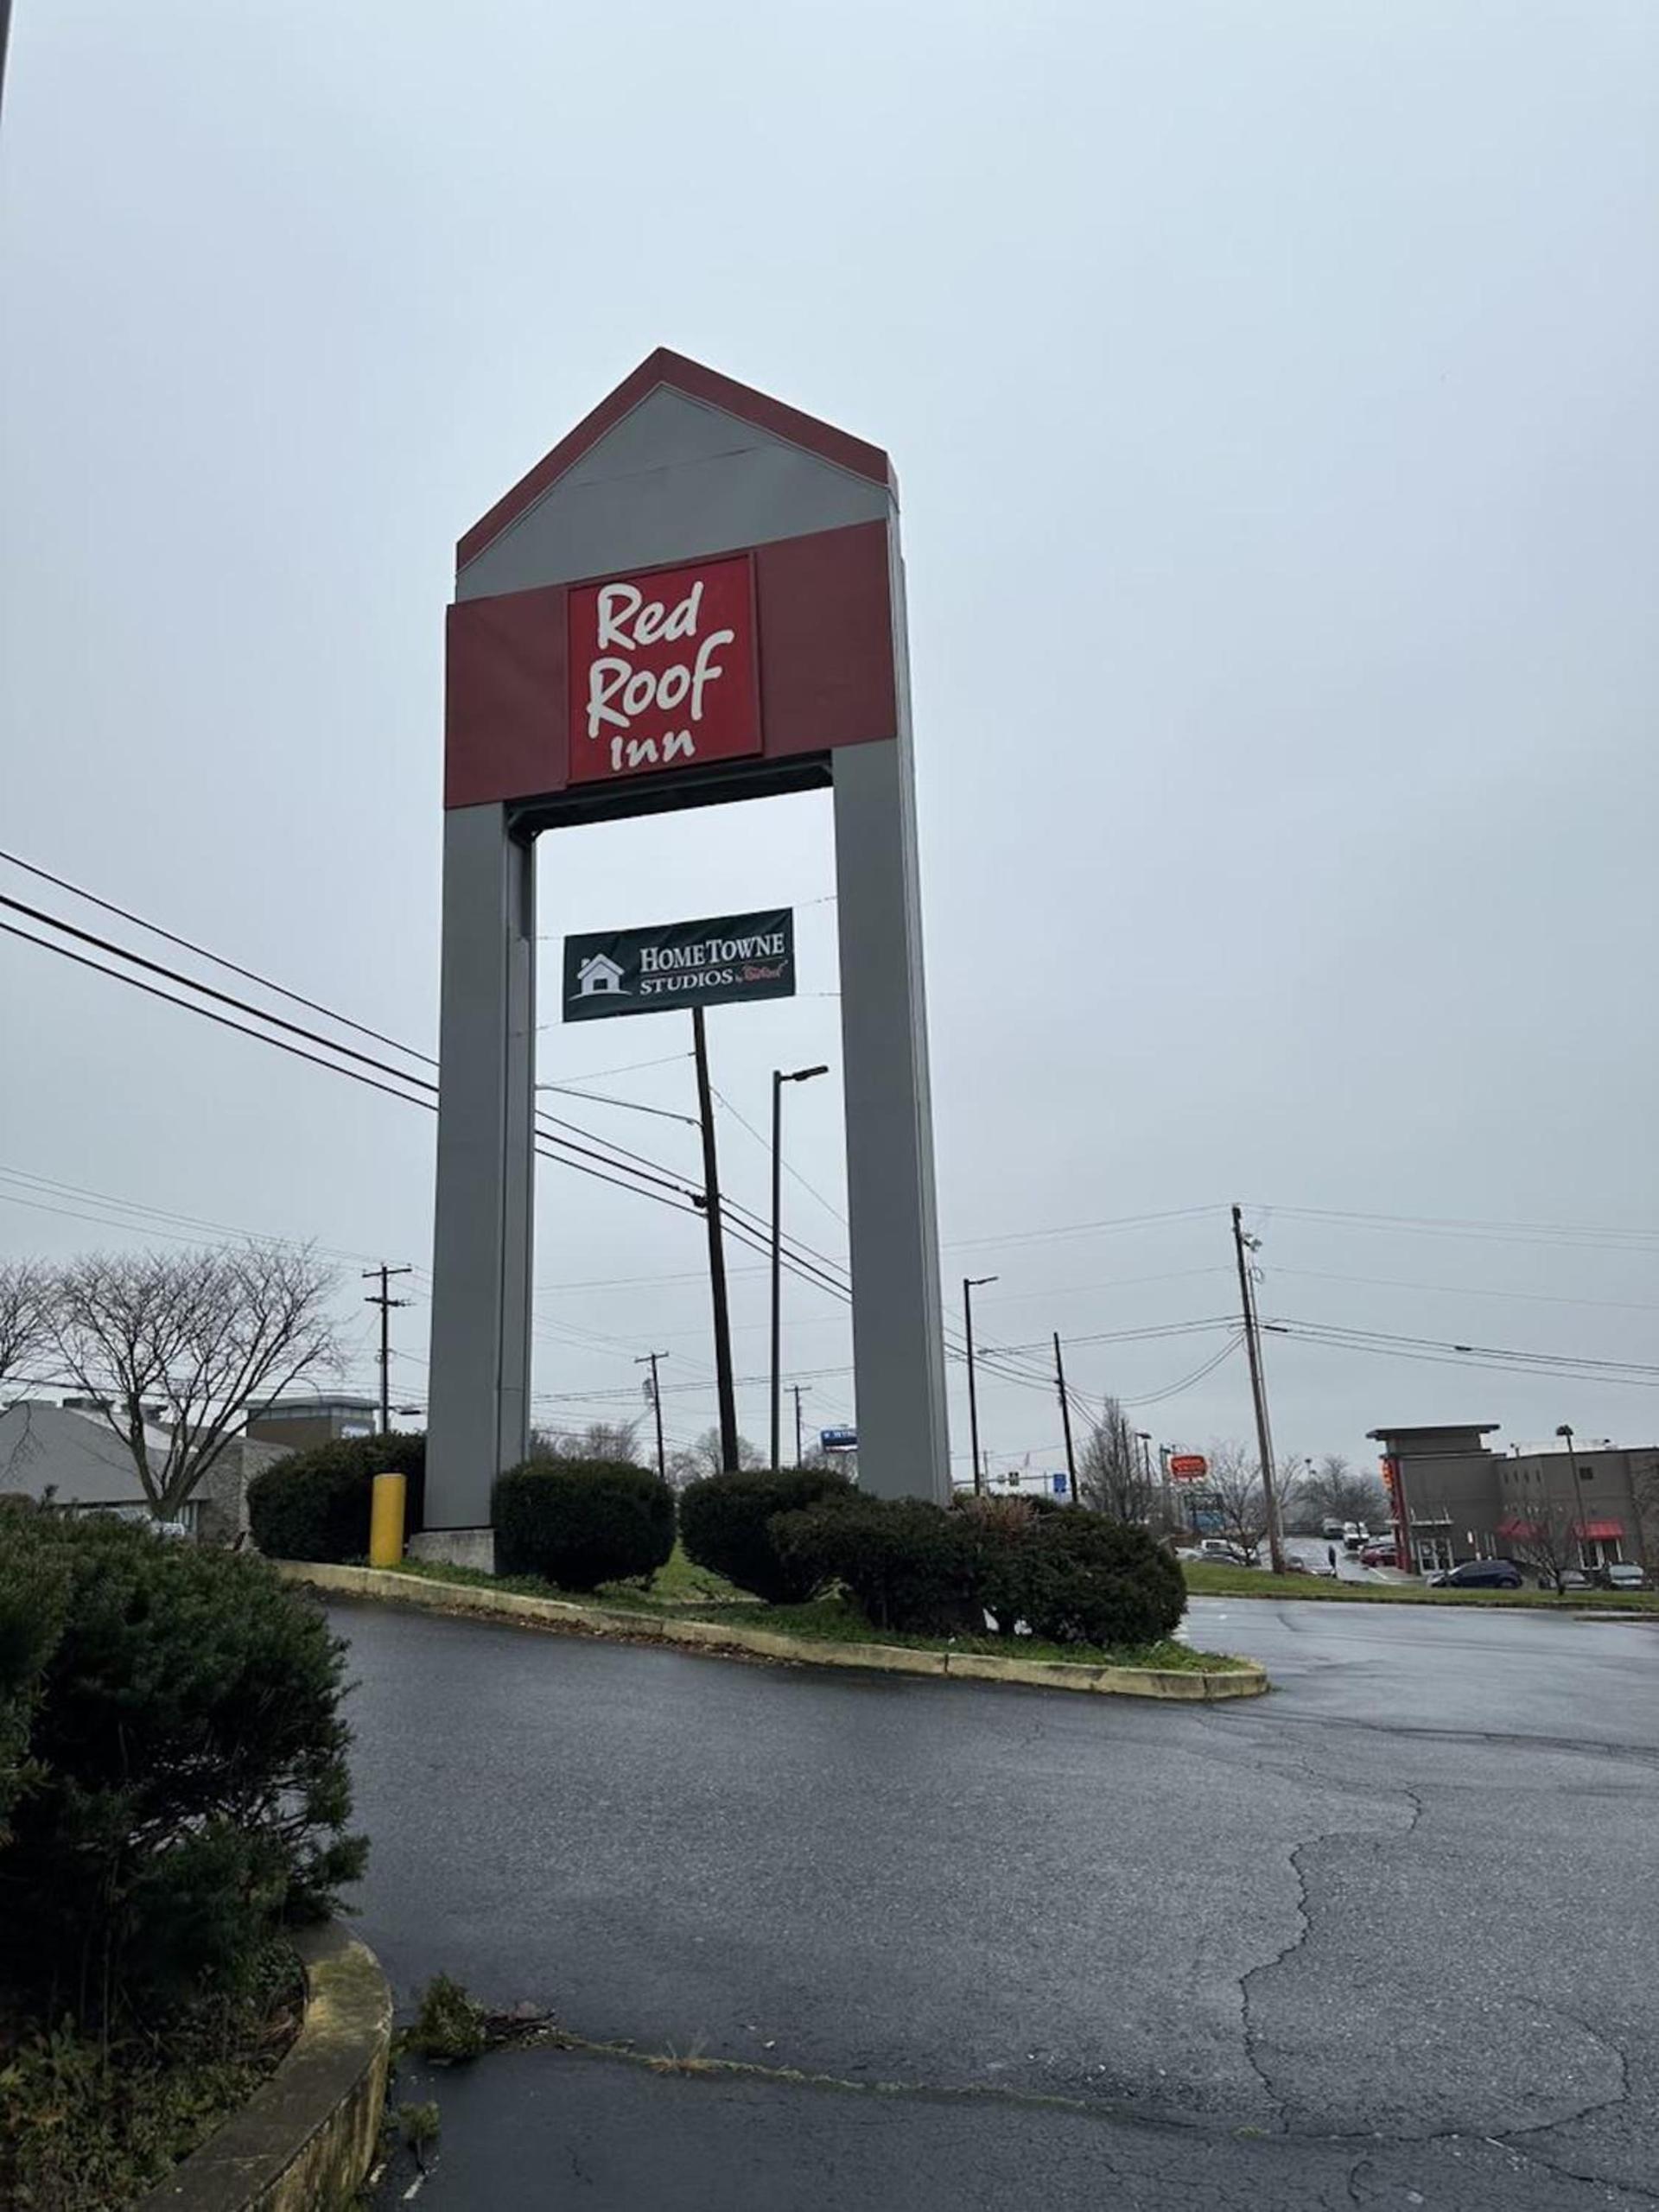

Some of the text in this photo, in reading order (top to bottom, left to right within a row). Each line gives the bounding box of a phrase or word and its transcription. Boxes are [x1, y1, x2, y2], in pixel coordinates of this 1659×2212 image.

[598, 581, 703, 650] Red
[587, 630, 734, 739] Roof
[640, 968, 734, 995] STUDIOS
